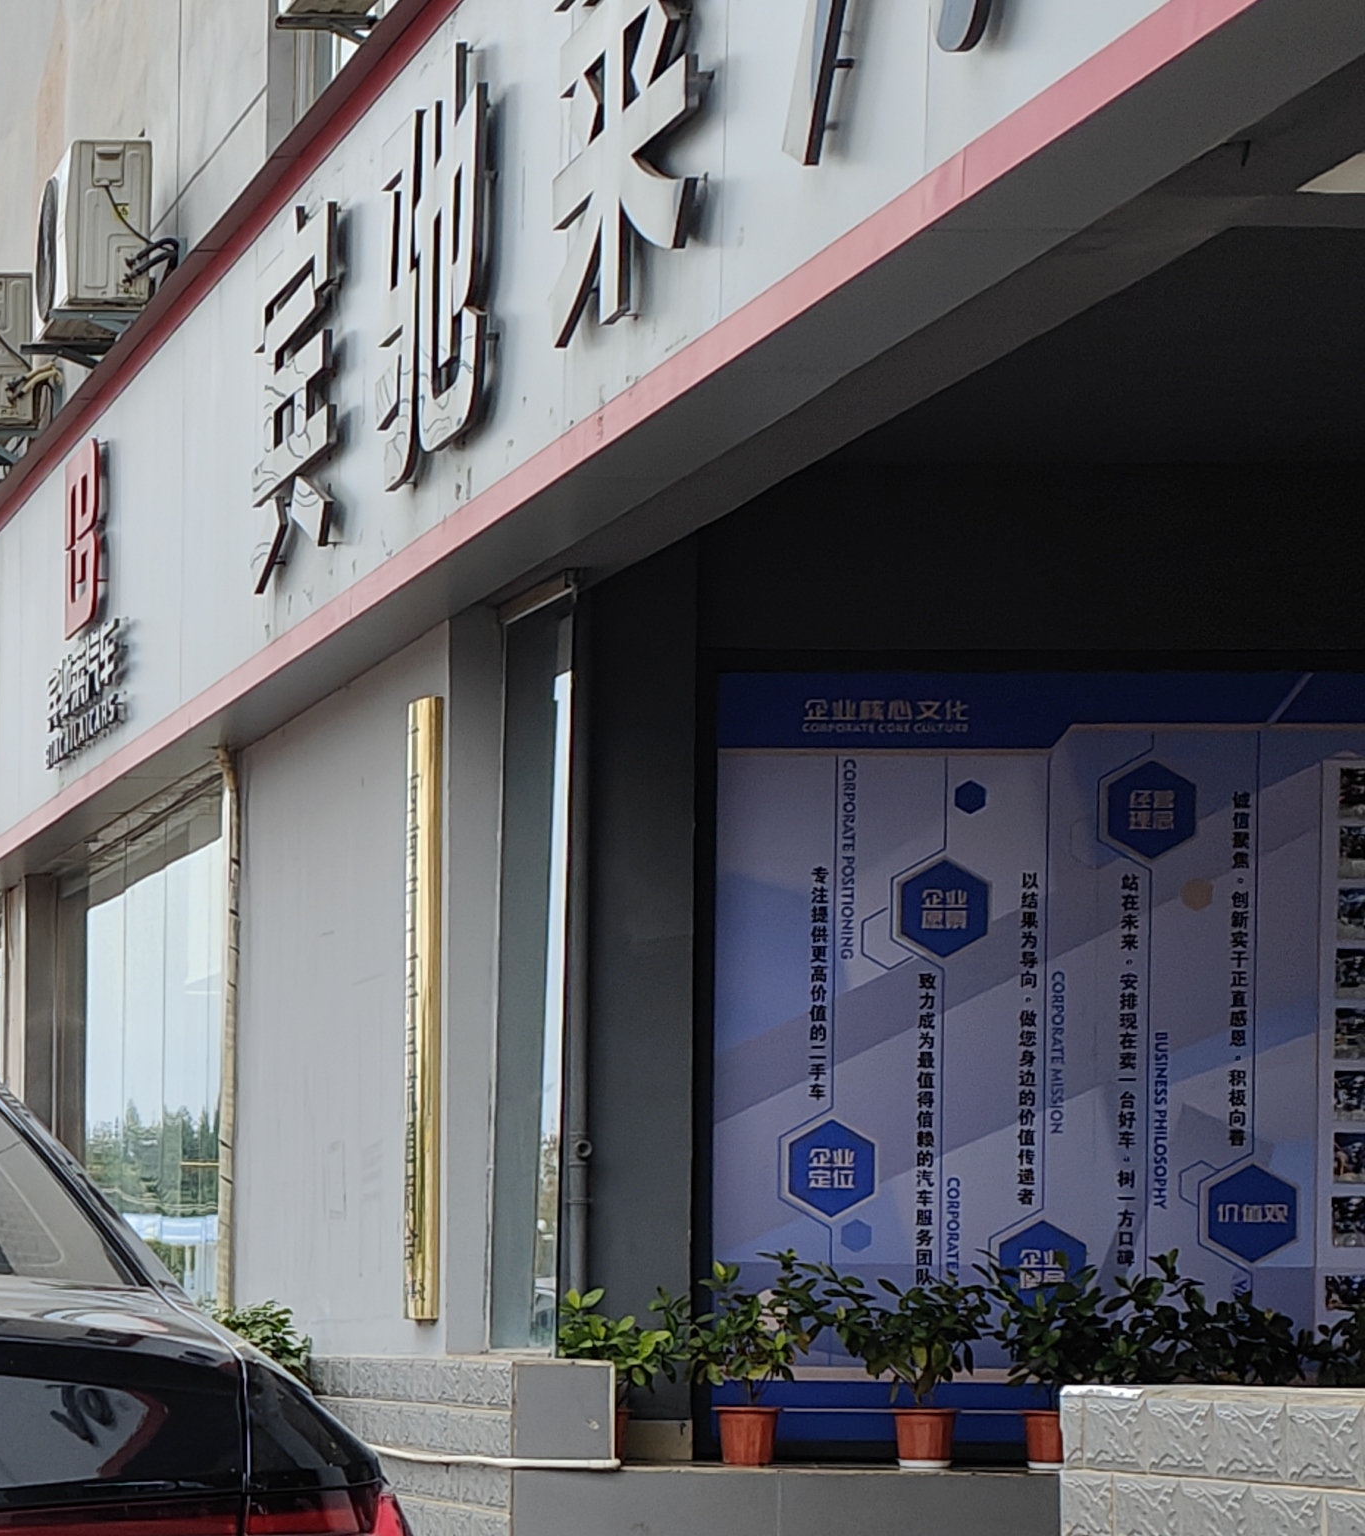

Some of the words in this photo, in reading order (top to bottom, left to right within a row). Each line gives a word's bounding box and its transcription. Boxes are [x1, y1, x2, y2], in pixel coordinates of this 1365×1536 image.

[802, 722, 874, 733] CORPORATE
[914, 722, 968, 733] CULTURE
[803, 699, 969, 721] 企业核心文化
[841, 758, 857, 852] CORPORATE
[840, 855, 856, 960] POSITIONING
[808, 866, 829, 1101] 专注提供更高价值的二手车
[1050, 970, 1066, 1065] CORPORATE
[1049, 1068, 1065, 1135] MISSION
[1154, 1031, 1169, 1106] BUSINESS
[808, 1148, 855, 1168] 企业
[808, 1169, 855, 1189] 定位
[1152, 1109, 1168, 1210] PHILOSOPHY
[946, 1176, 961, 1271] CORPORATE
[1216, 1203, 1289, 1224] 价值观
